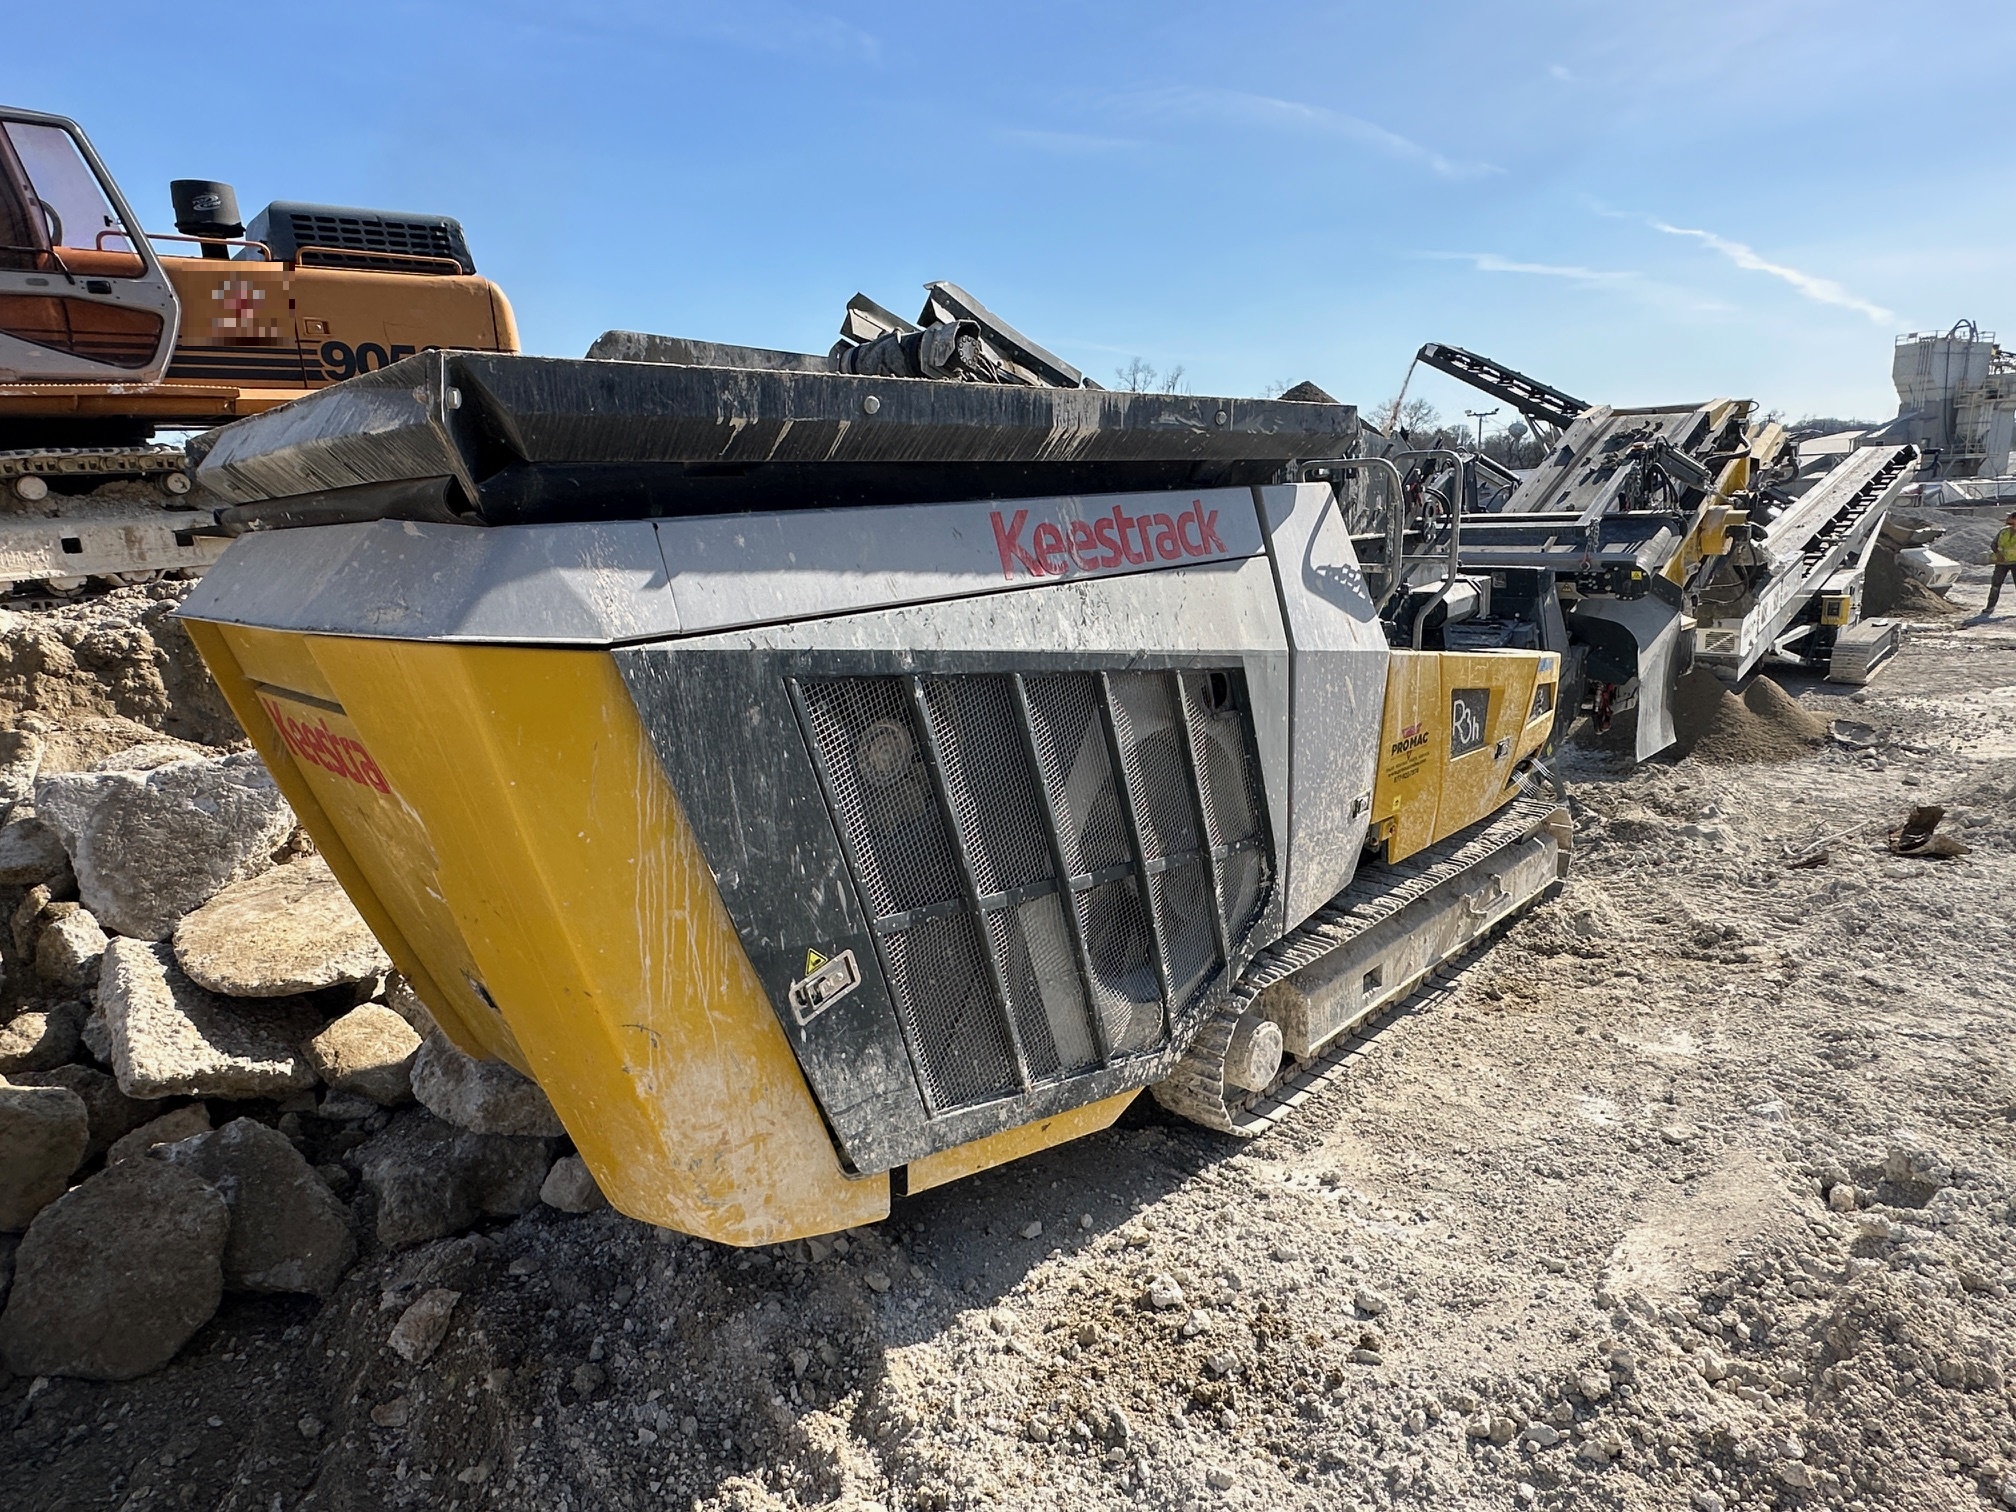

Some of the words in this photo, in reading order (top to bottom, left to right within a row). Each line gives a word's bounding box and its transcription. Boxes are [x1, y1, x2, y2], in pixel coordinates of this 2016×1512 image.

[989, 499, 1227, 581] Keestrack
[261, 697, 391, 795] Keestra
[1391, 731, 1430, 756] PROMAC
[1452, 699, 1480, 744] R3h
